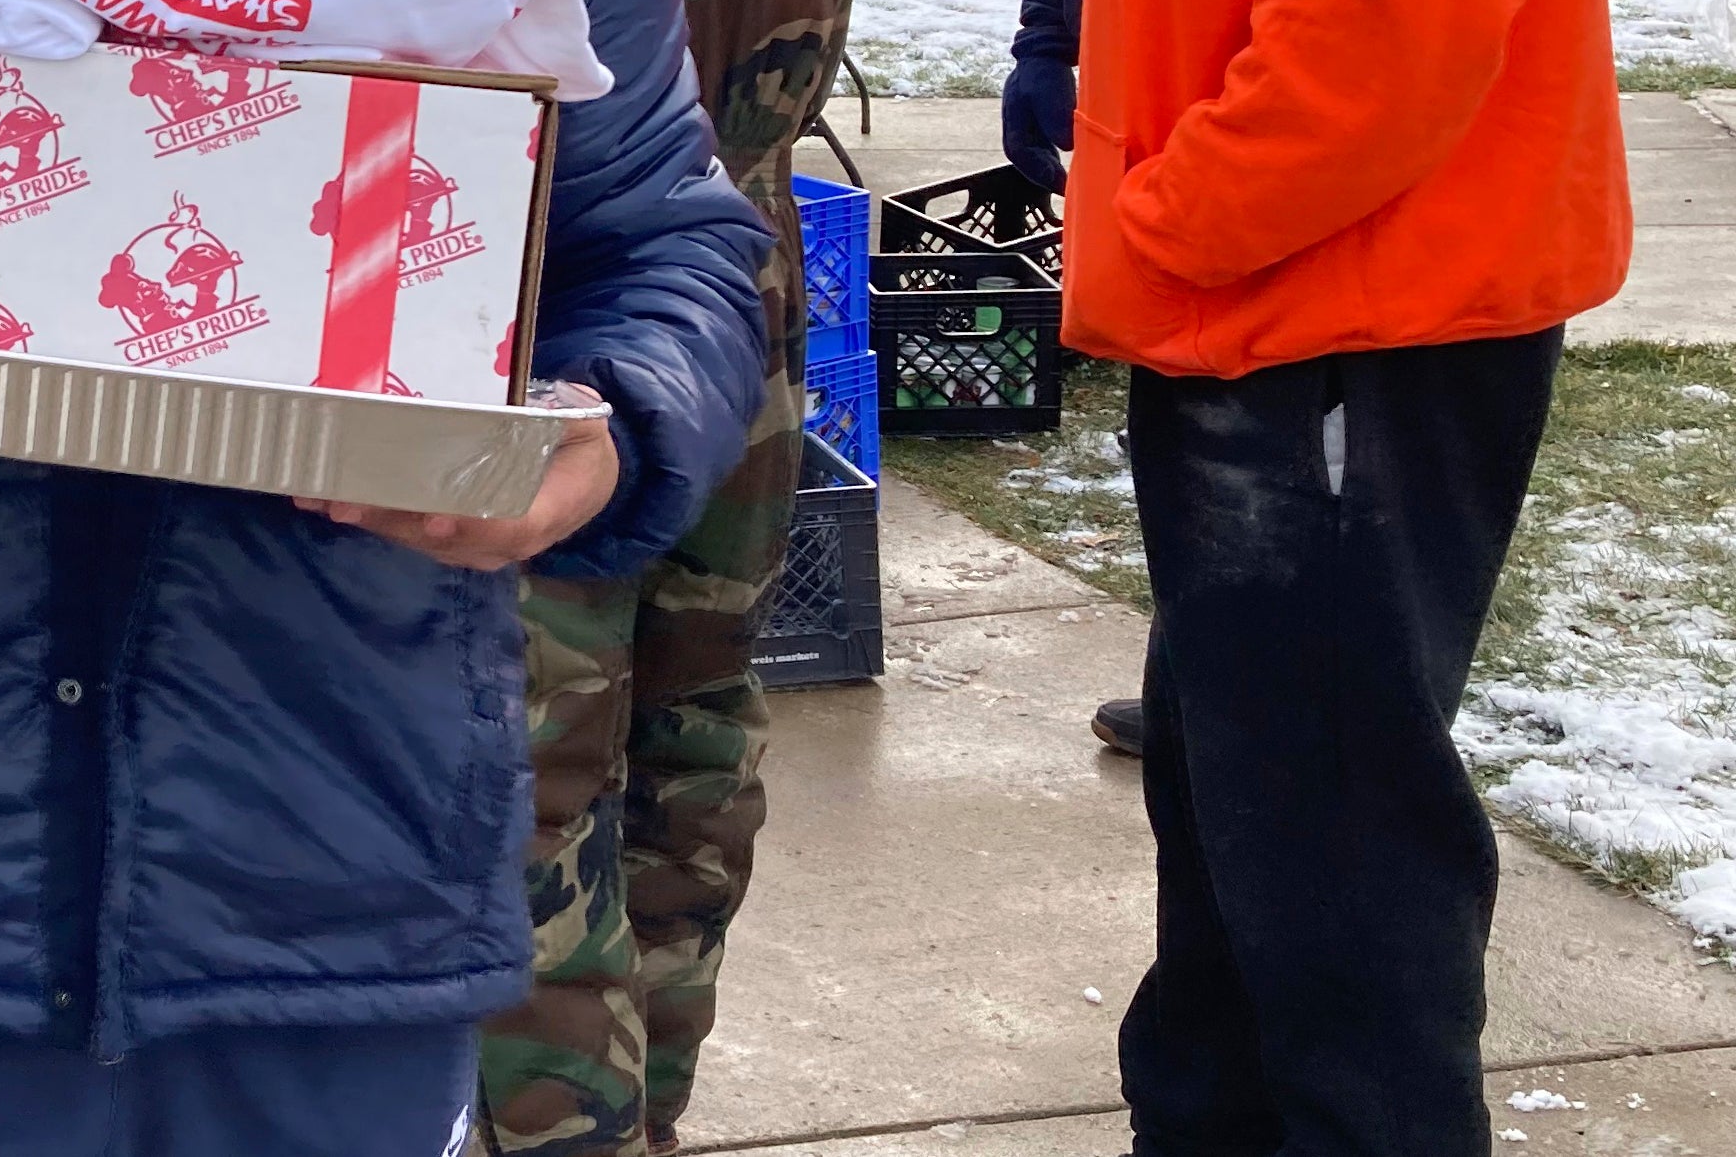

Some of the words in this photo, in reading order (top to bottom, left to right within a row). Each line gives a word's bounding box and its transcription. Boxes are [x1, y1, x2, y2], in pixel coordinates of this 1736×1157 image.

[155, 112, 225, 150] CHEF'S
[197, 135, 232, 156] SINCE
[233, 126, 261, 144] 1894
[25, 202, 51, 220] 1894
[415, 267, 444, 285] 1894
[123, 325, 194, 362] CHEF'S
[166, 349, 200, 369] SINCE
[202, 340, 229, 358] 1894
[775, 652, 820, 663] markets
